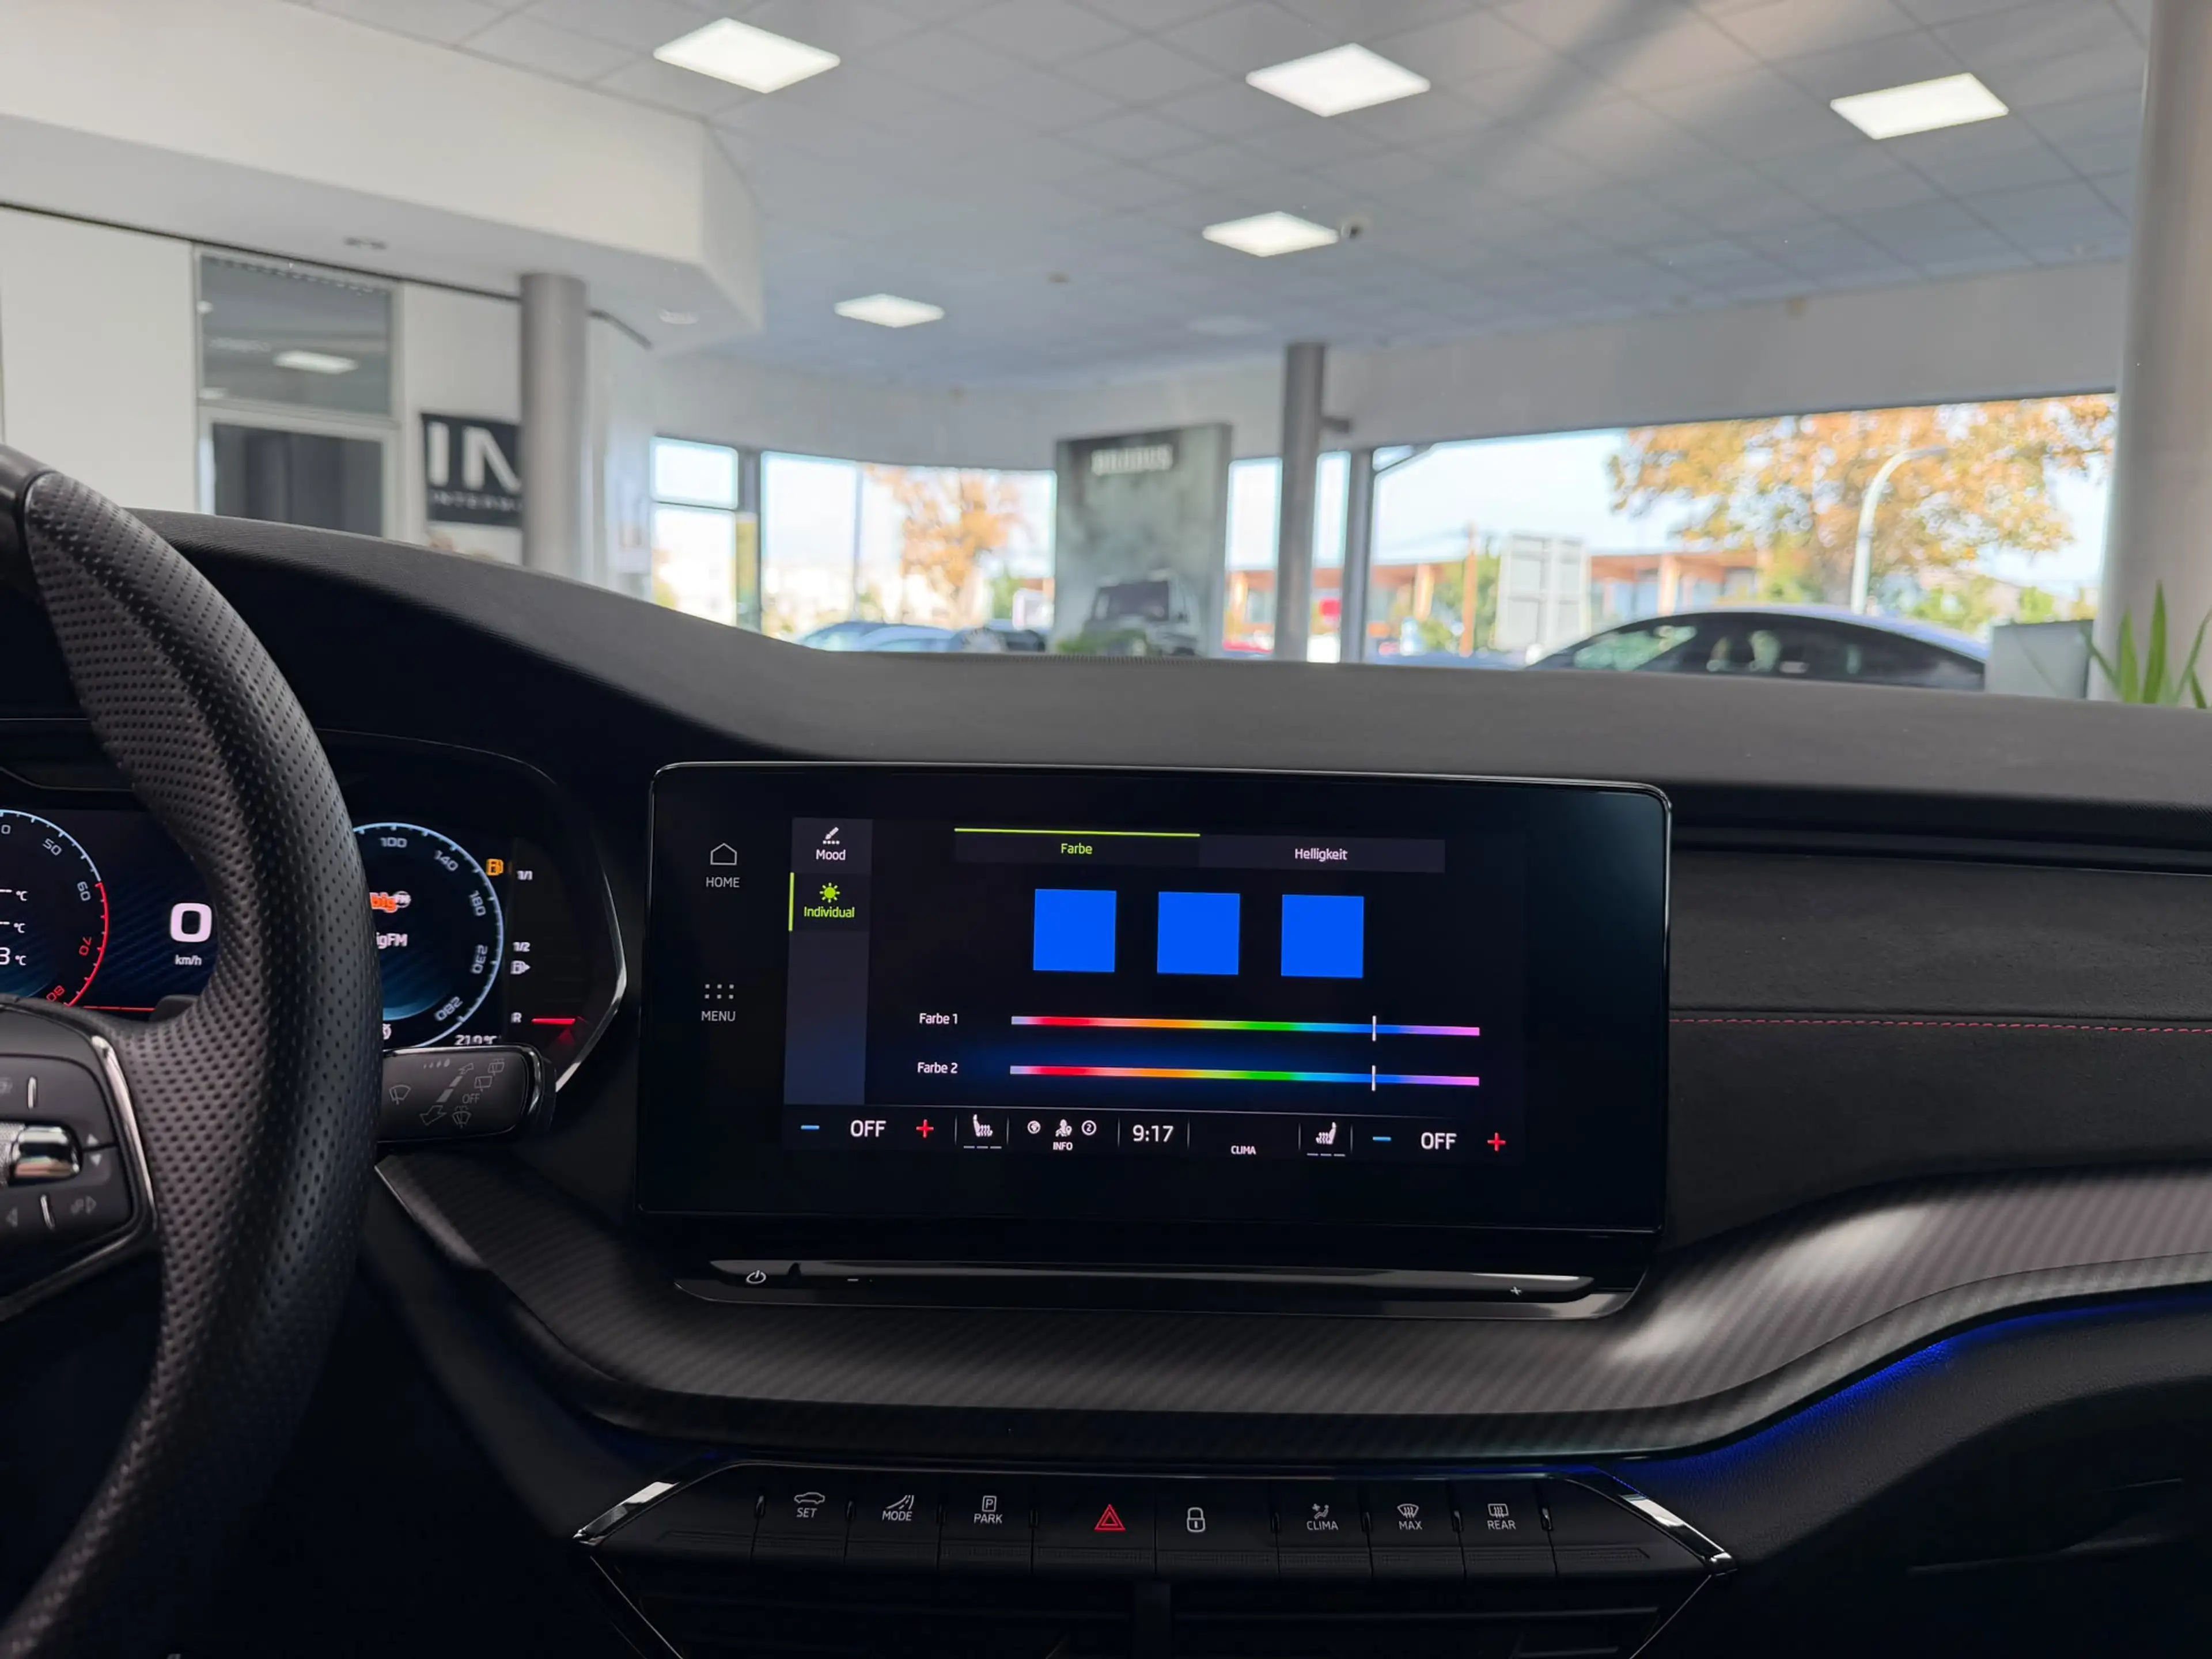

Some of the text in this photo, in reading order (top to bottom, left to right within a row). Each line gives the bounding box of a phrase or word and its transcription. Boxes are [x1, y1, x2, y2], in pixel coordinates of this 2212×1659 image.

[43, 838, 62, 856] 50
[380, 836, 407, 848] 100
[1061, 842, 1093, 854] Farbe
[816, 849, 846, 861] Mood
[1294, 847, 1348, 862] Helligkeit
[434, 850, 459, 872] 140
[517, 870, 533, 880] 1/1
[706, 877, 740, 888] HOME
[77, 881, 91, 902] 60
[469, 890, 487, 916] 180
[804, 906, 855, 918] Individual
[170, 903, 212, 942] 0
[78, 937, 92, 956] 70
[513, 941, 531, 952] 1/2
[175, 955, 202, 965] km/h
[471, 944, 488, 974] 230
[46, 985, 65, 1002] 80
[434, 996, 463, 1021] 280
[511, 1012, 522, 1023] R
[701, 1010, 736, 1022] MENU
[919, 1013, 958, 1025] Farbe 1
[917, 1062, 958, 1074] Farbe 2
[463, 1093, 480, 1104] OFF
[850, 1120, 887, 1137] OFF
[1132, 1124, 1174, 1142] 9:17
[1052, 1141, 1073, 1151] INFO
[1421, 1132, 1457, 1150] OFF
[1230, 1145, 1256, 1155] CLIMA
[796, 1507, 817, 1518] SET
[882, 1510, 912, 1521] MODE
[974, 1513, 1002, 1524] PARK
[1306, 1520, 1339, 1531] CLIMA
[1399, 1520, 1423, 1530] MAX
[1487, 1520, 1516, 1530] REAR
